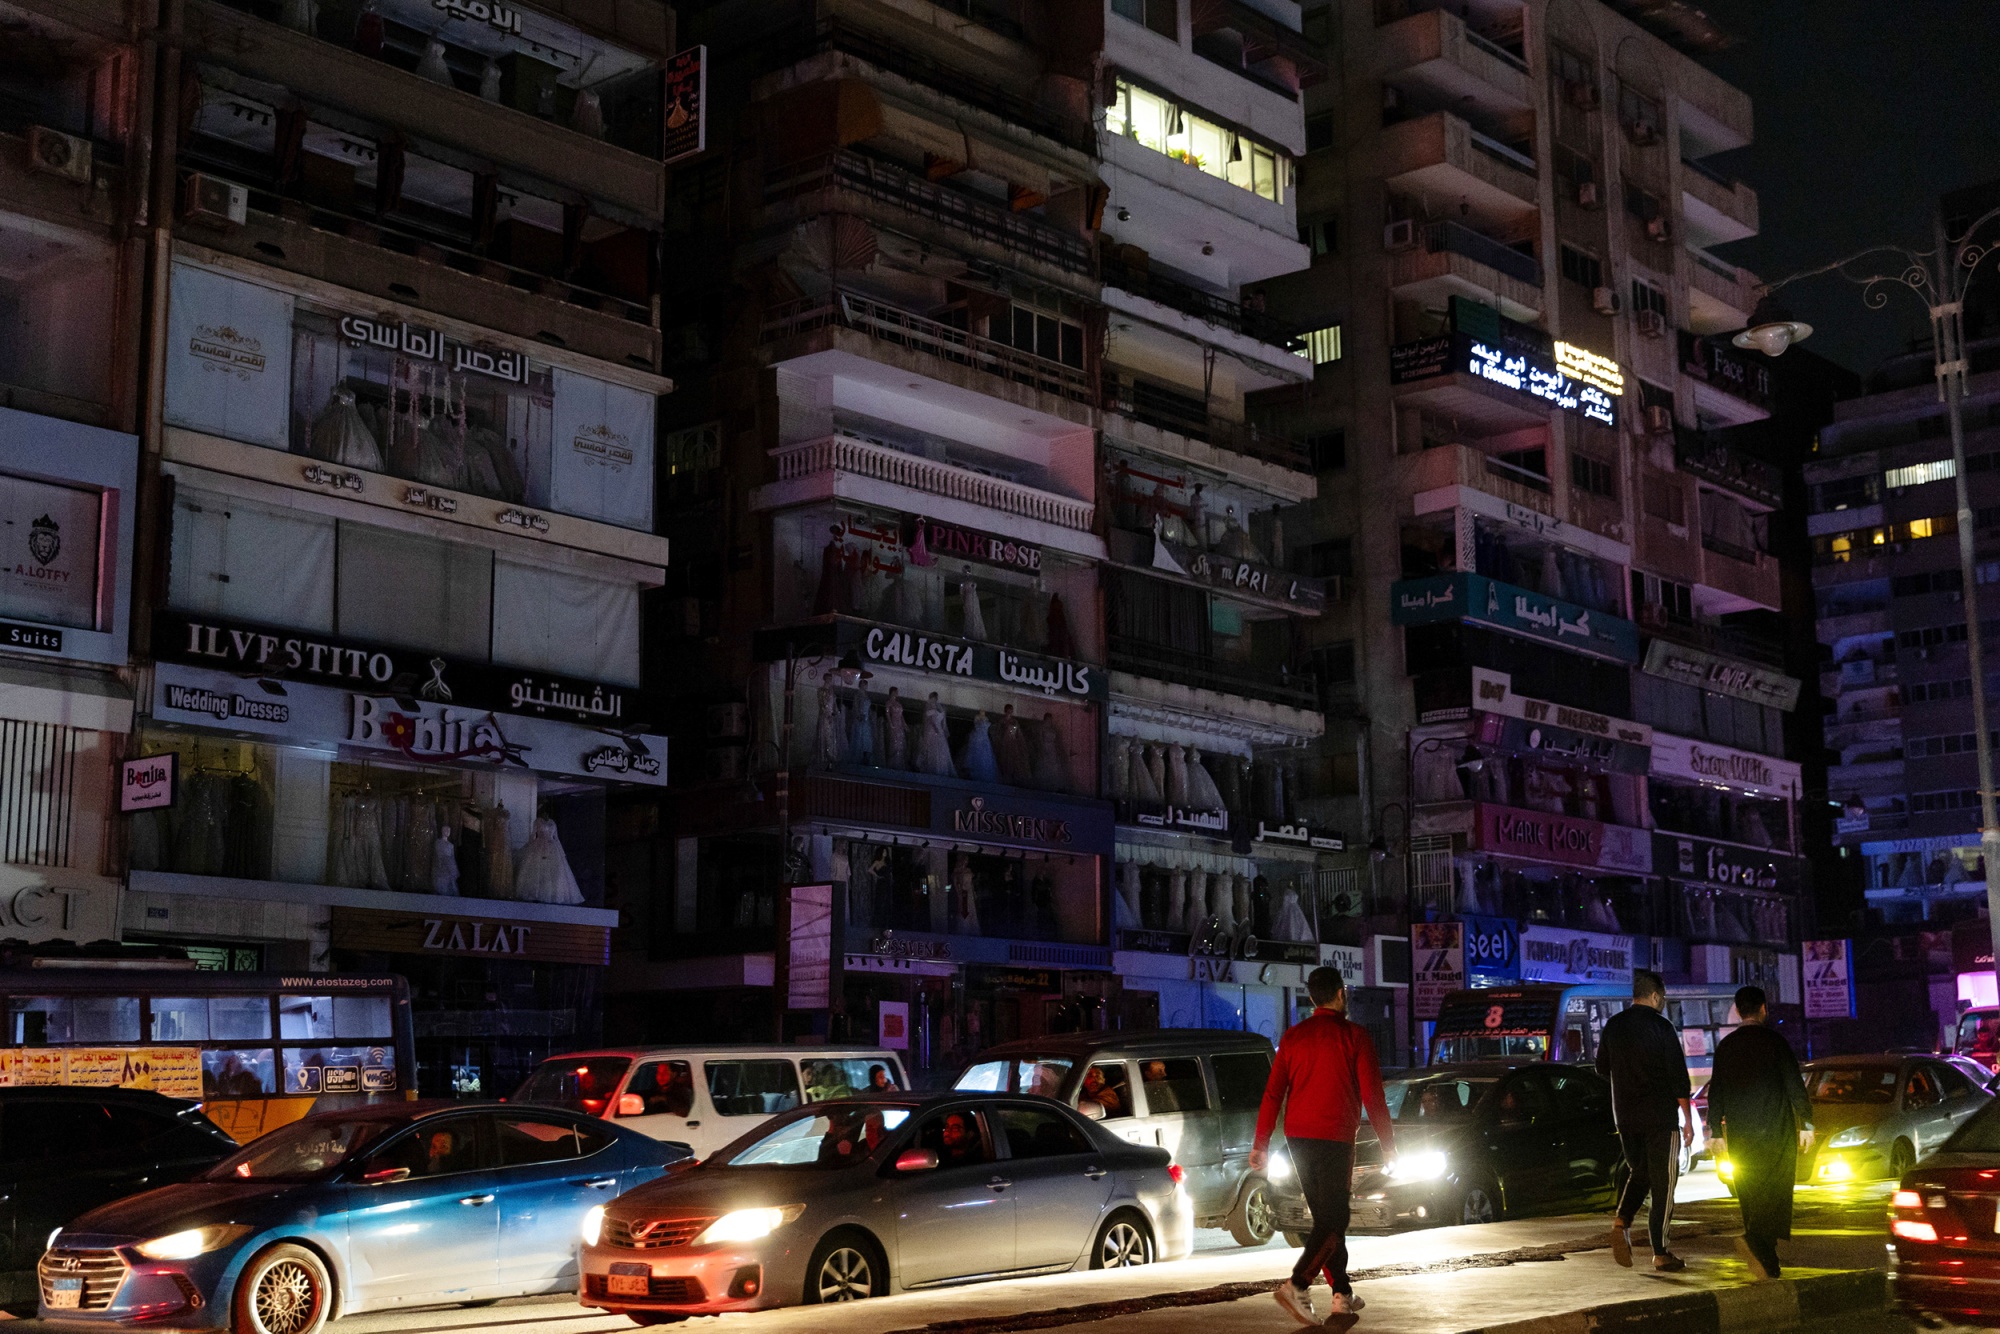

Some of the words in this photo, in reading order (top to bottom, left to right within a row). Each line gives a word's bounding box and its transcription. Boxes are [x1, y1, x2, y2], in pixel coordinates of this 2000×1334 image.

[341, 317, 445, 362] الماسي
[453, 347, 531, 385] القصر
[15, 564, 70, 582] A.LOTFY
[1401, 583, 1453, 608] كراميلا
[1515, 595, 1591, 636] كراميلا
[11, 629, 59, 648] Suits
[866, 628, 973, 676] CALISTA
[1000, 651, 1090, 695] كاليستا
[169, 686, 230, 719] Wedding
[235, 694, 289, 722] Dresses
[633, 754, 660, 775] جملة
[1254, 817, 1308, 842] قصر
[423, 919, 532, 954] ZALAT
[1484, 1004, 1506, 1029] 8
